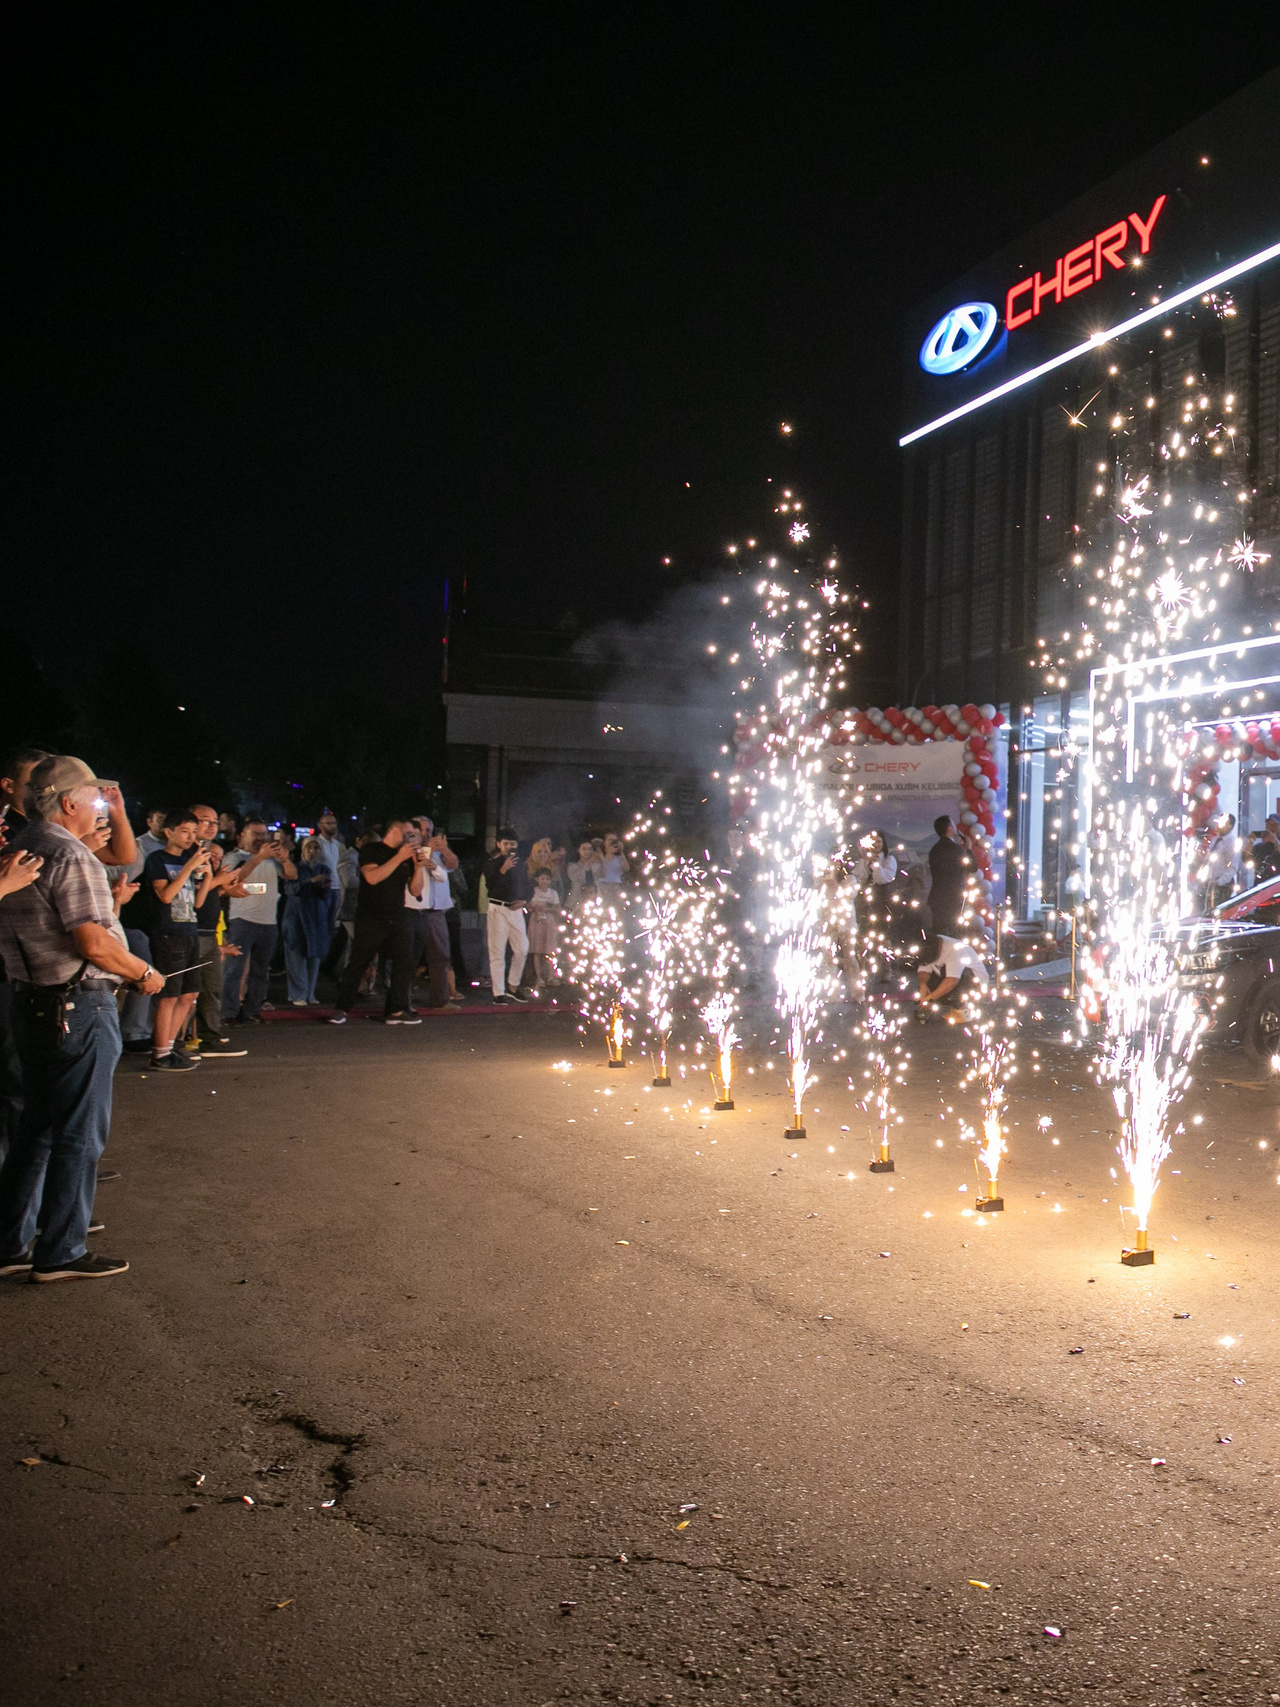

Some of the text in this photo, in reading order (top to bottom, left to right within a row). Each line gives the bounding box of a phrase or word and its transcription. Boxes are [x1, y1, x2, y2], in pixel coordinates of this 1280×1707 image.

[1005, 194, 1168, 331] CHERY
[864, 762, 921, 773] CHERY
[895, 782, 919, 791] XUSH
